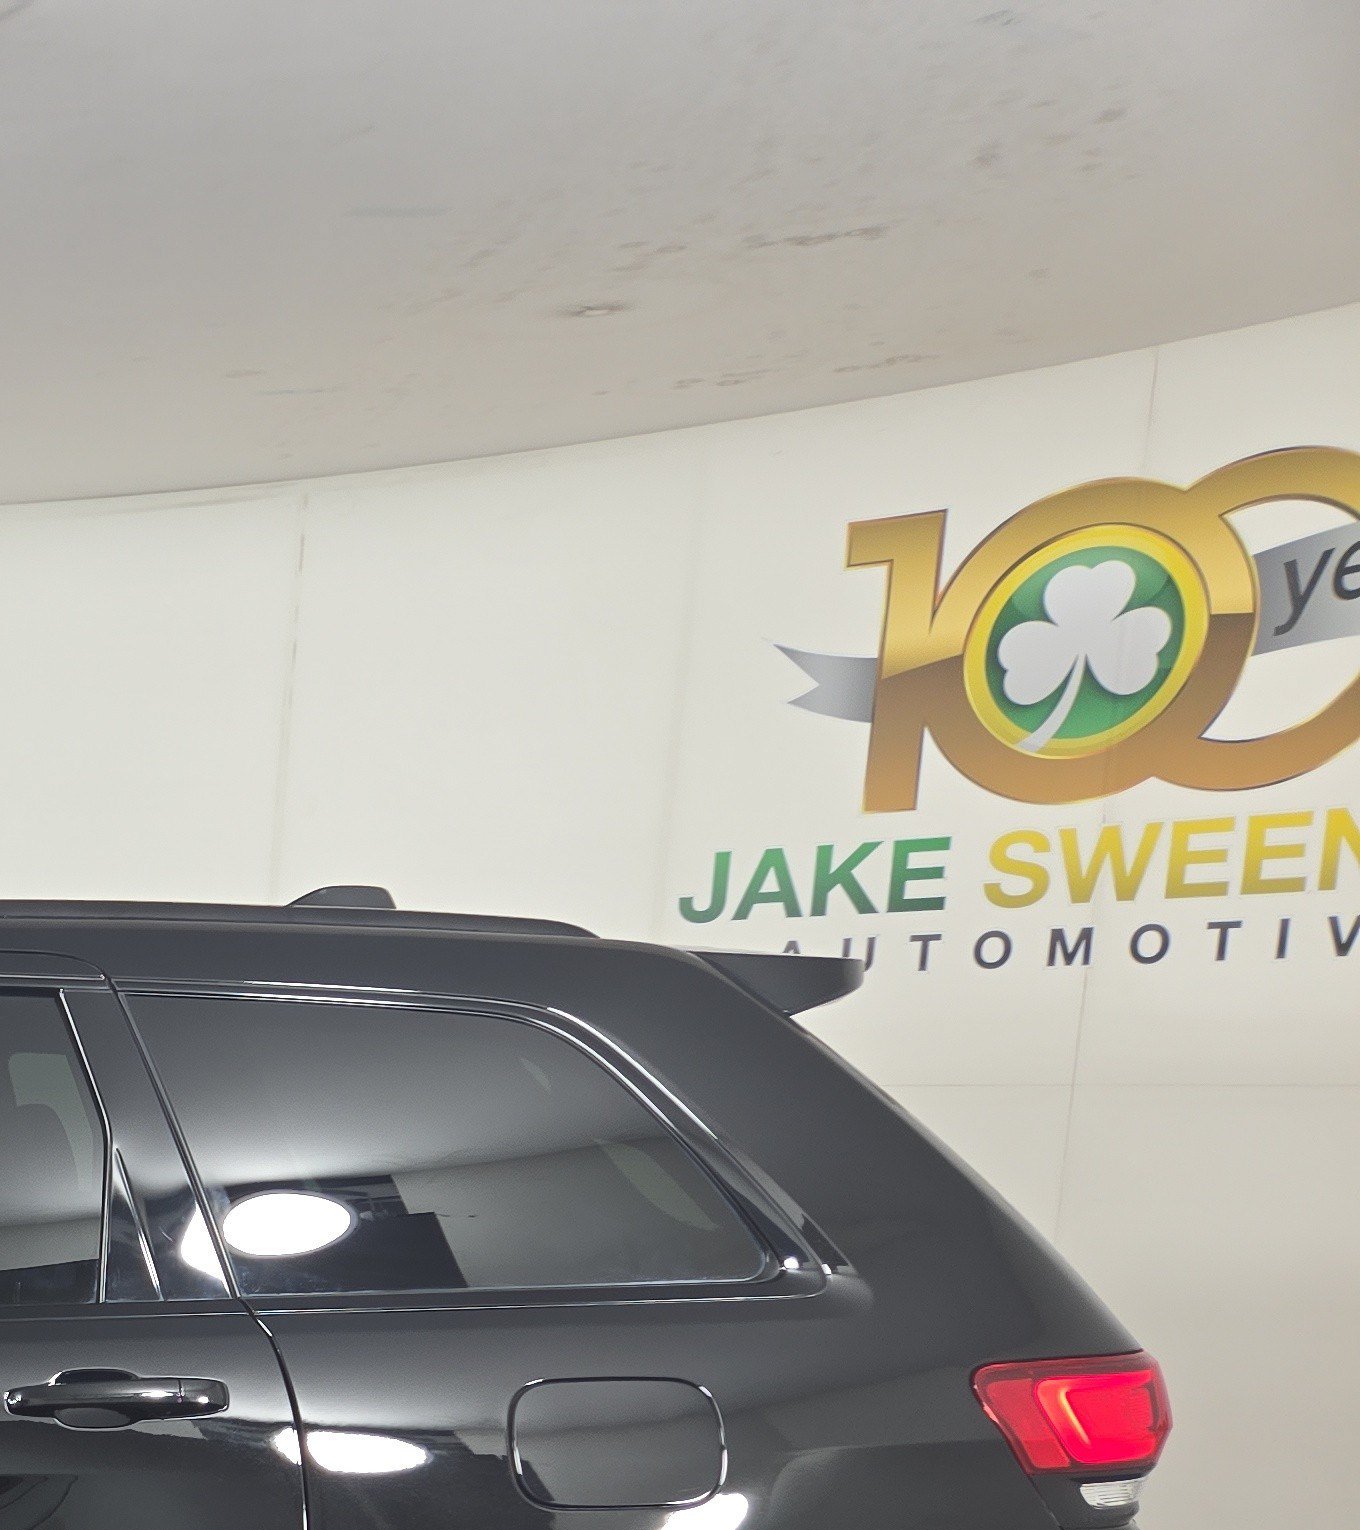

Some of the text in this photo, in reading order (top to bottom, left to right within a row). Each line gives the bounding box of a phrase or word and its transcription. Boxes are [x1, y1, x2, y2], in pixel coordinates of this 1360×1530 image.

[678, 808, 1360, 924] JAKE SWEEN
[783, 914, 1360, 973] UTOMOTIV
